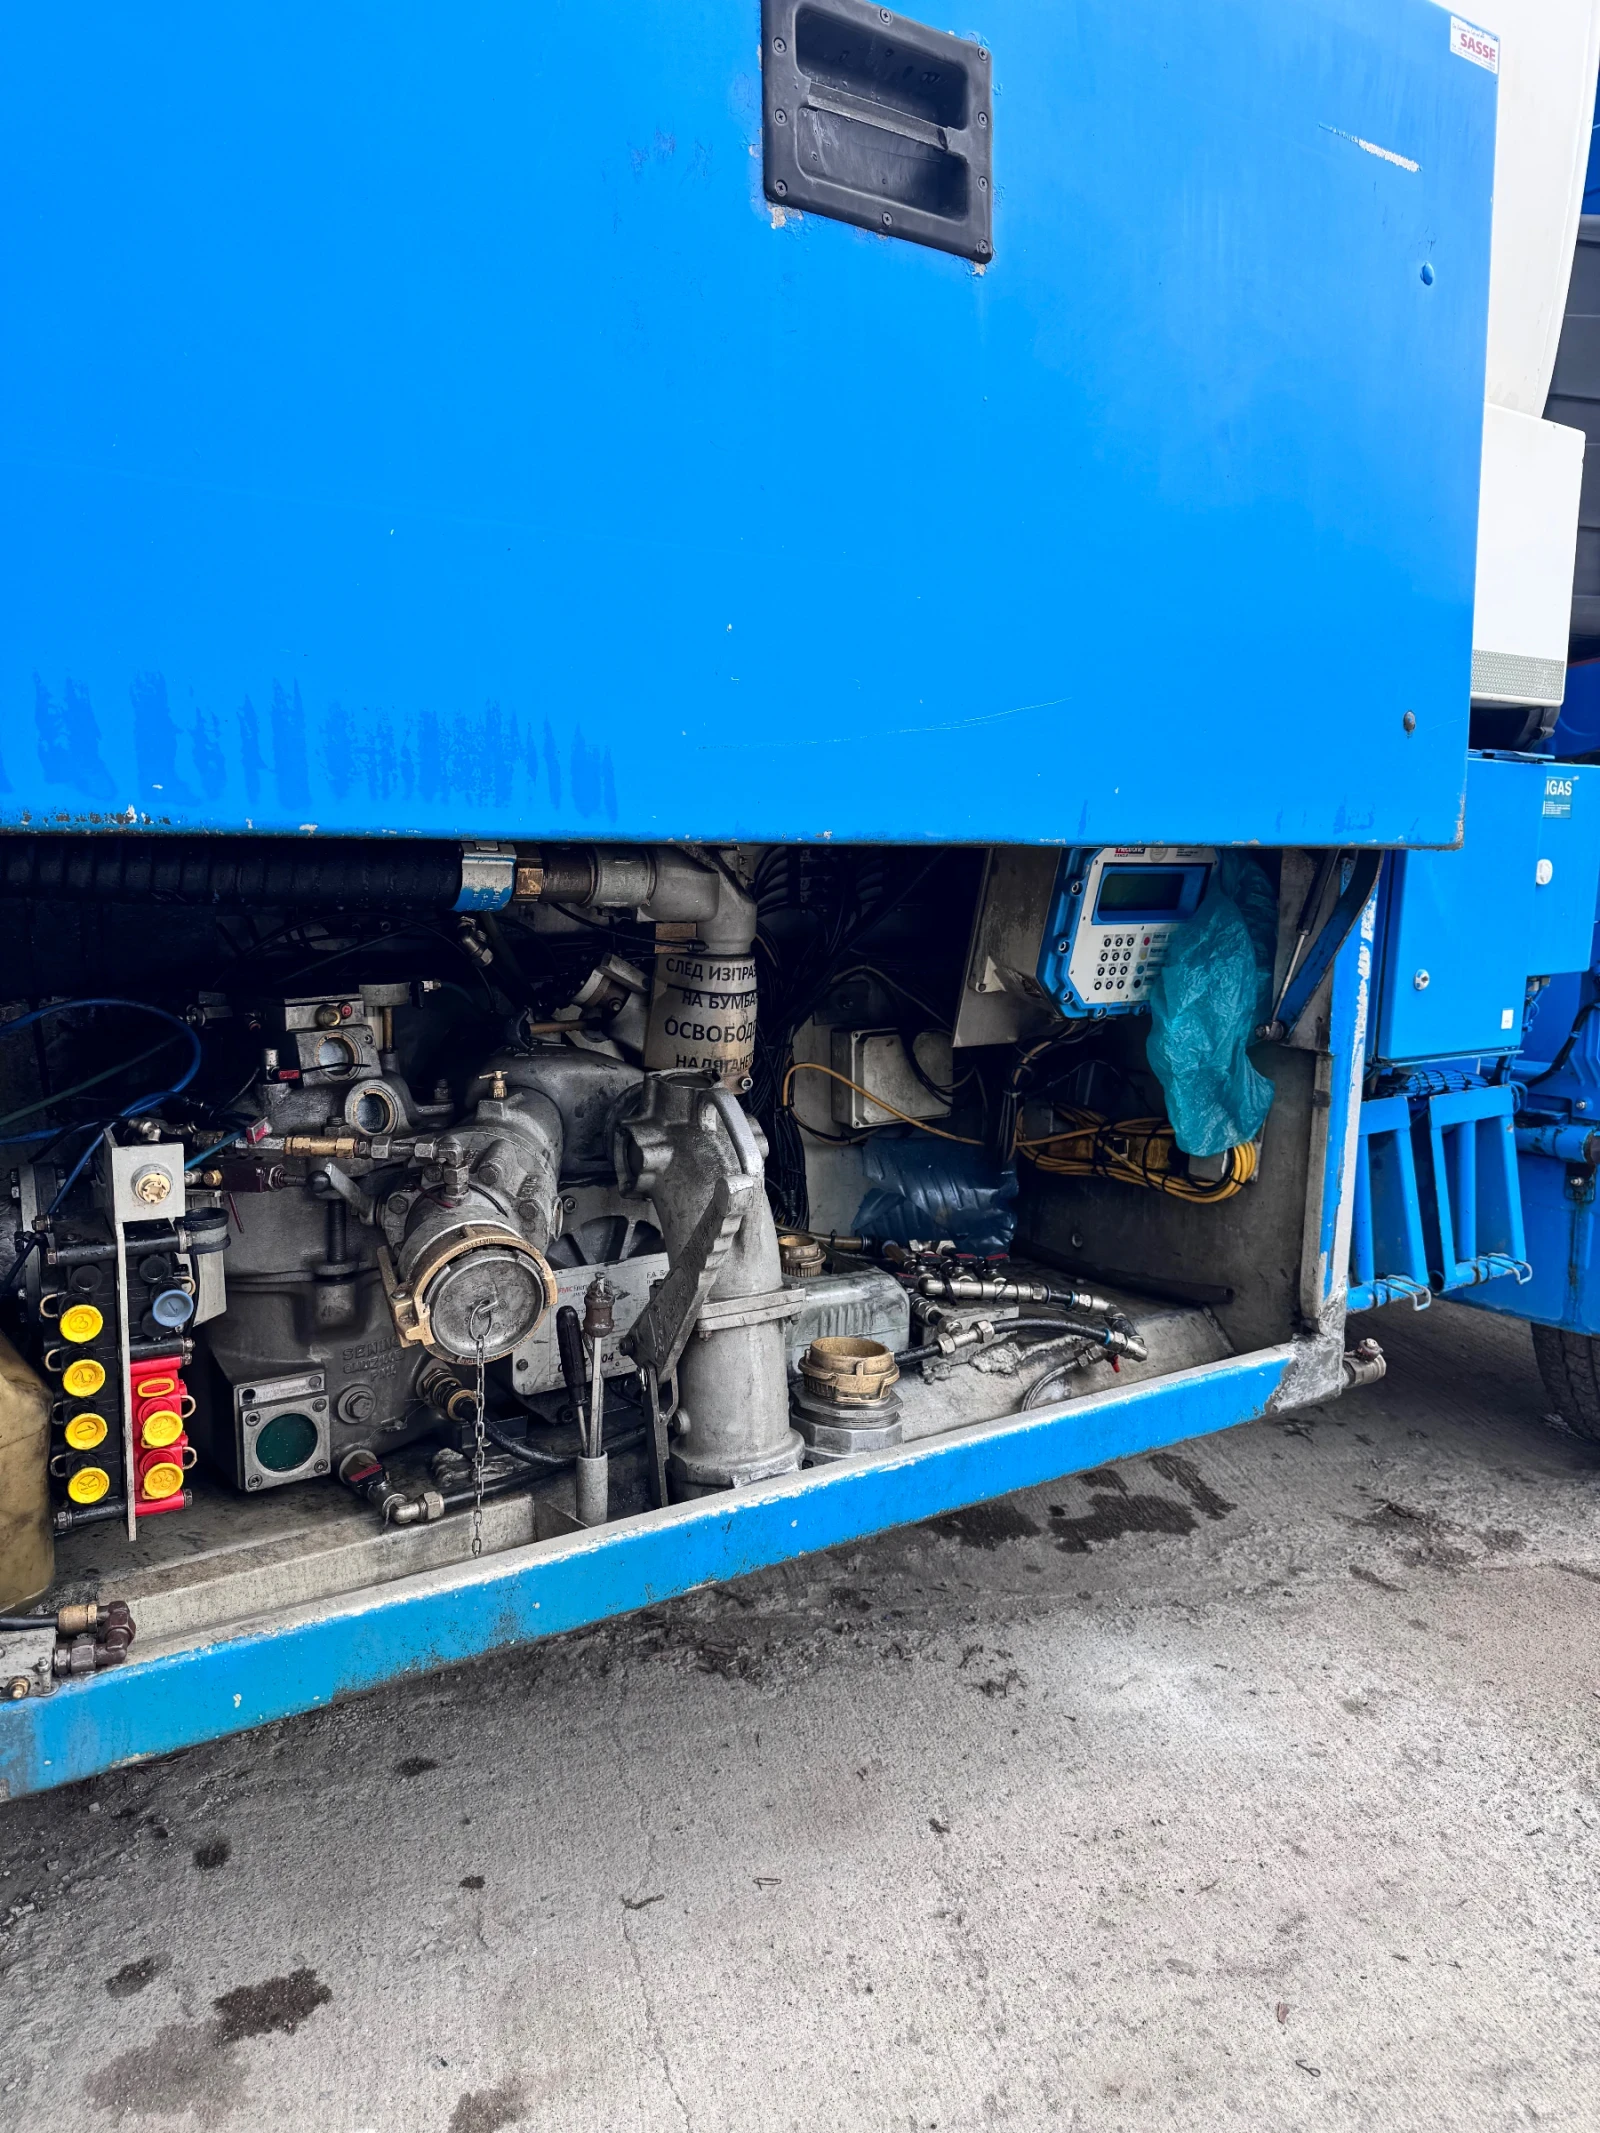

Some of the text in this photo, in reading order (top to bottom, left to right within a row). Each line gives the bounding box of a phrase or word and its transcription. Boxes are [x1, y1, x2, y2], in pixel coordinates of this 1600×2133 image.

[1460, 33, 1496, 63] SASSE
[1546, 780, 1572, 796] IGAS
[666, 958, 704, 982] СЛЕД
[682, 989, 758, 1010] НА БУМБА
